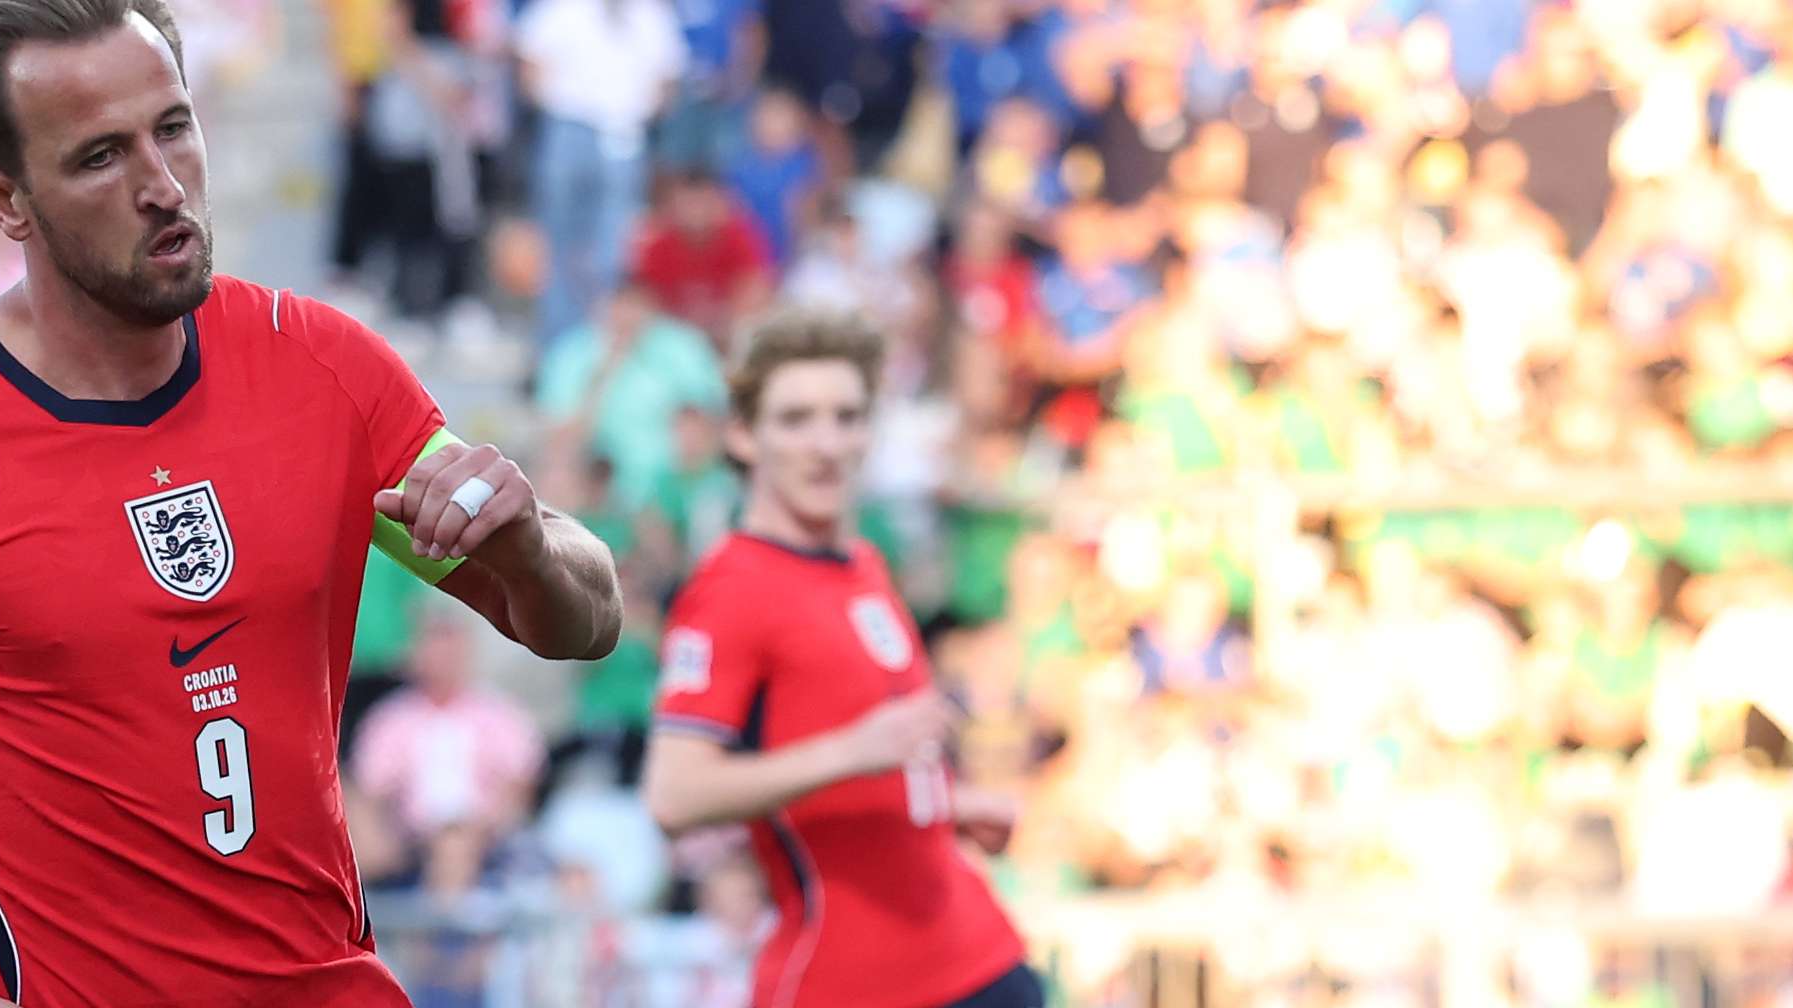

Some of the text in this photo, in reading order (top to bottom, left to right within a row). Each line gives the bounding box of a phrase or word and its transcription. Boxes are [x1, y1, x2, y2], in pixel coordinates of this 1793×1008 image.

[183, 664, 238, 692] CROATIA
[192, 685, 238, 713] 03.10.26
[195, 716, 256, 857] 9
